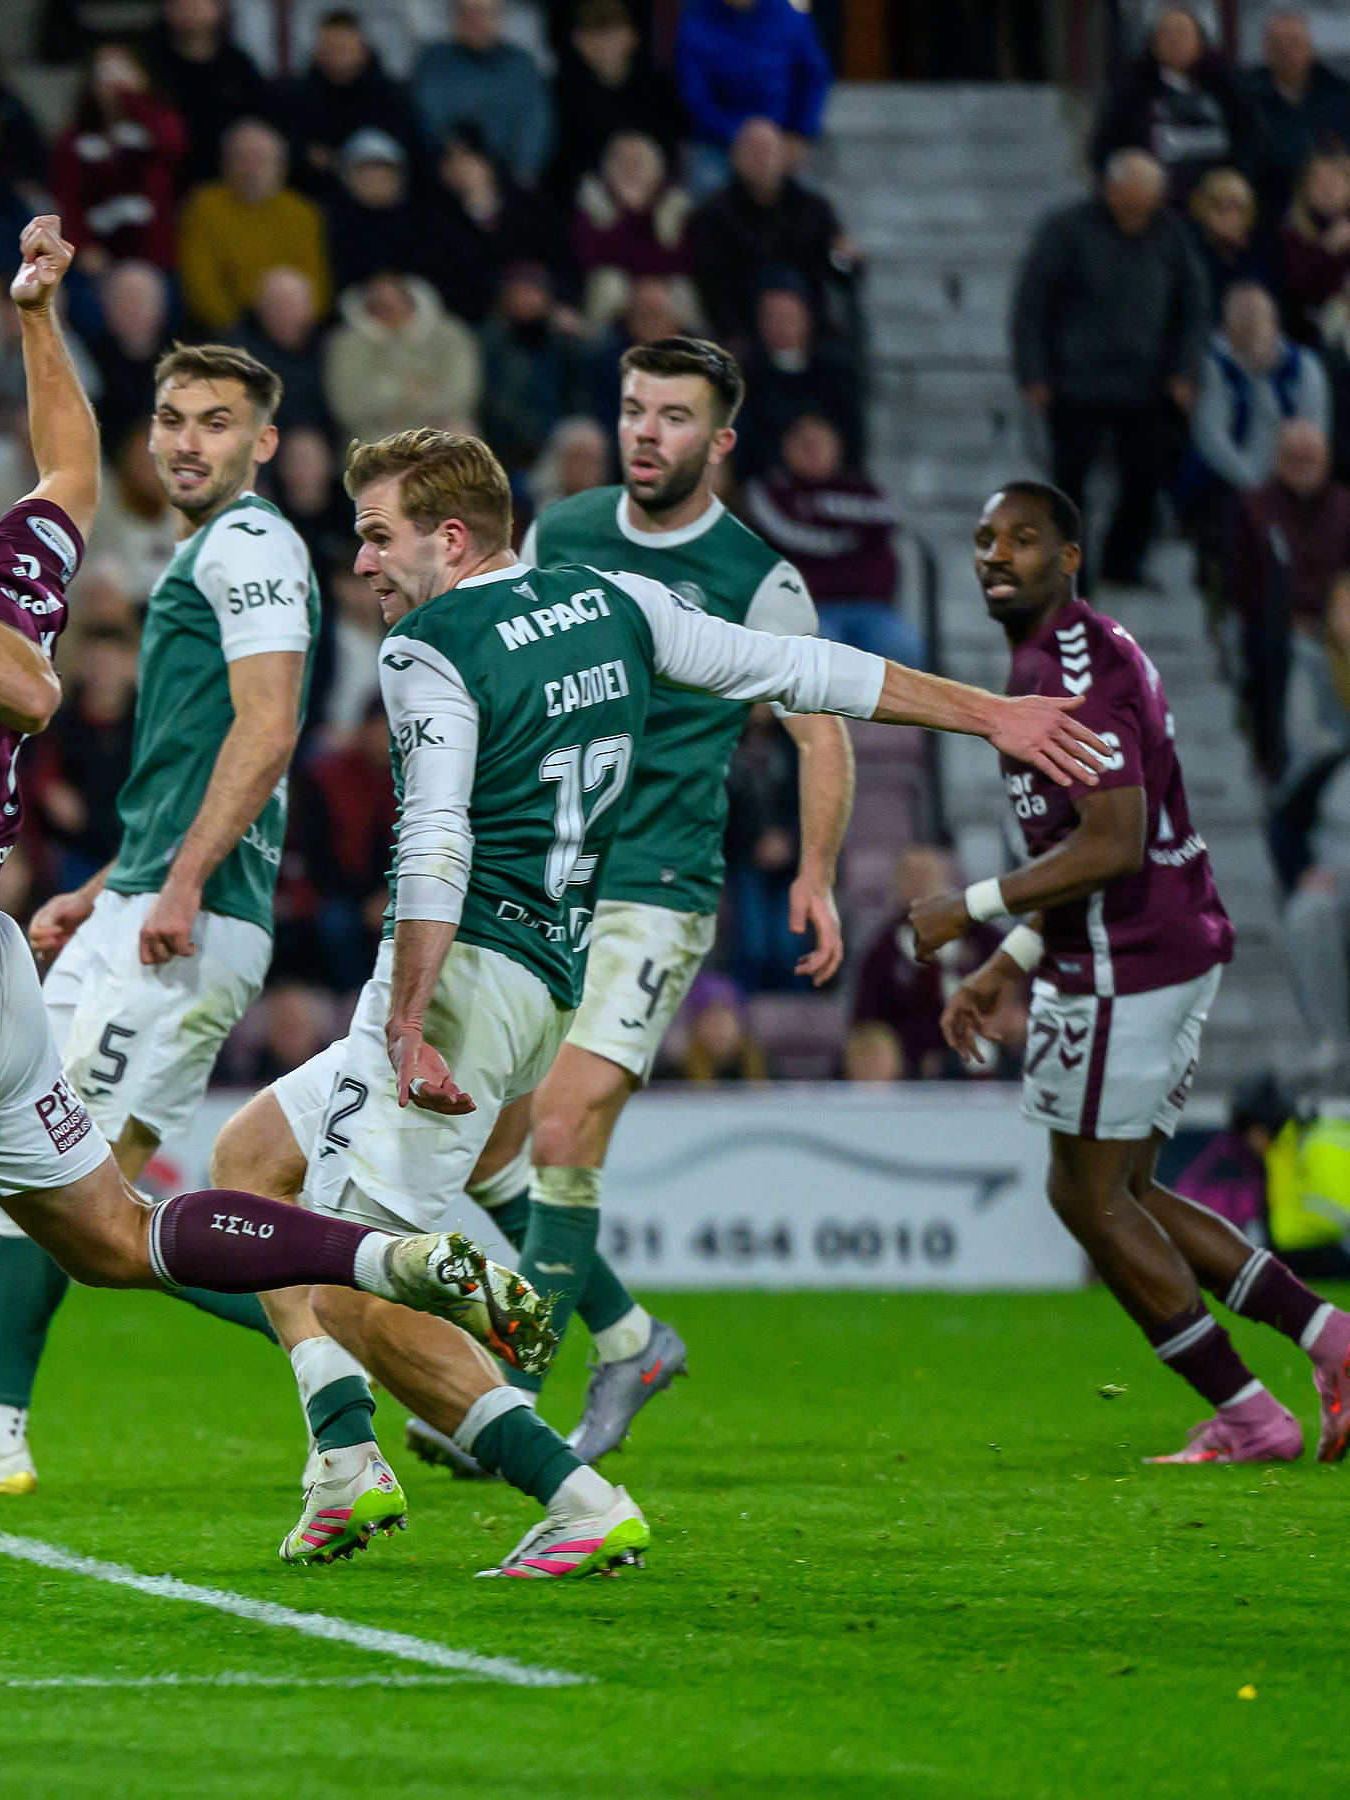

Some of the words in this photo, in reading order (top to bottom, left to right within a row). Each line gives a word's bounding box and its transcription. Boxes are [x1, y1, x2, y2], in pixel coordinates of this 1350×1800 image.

[538, 733, 634, 901] 12
[637, 958, 671, 1020] 4
[90, 1023, 138, 1085] 5
